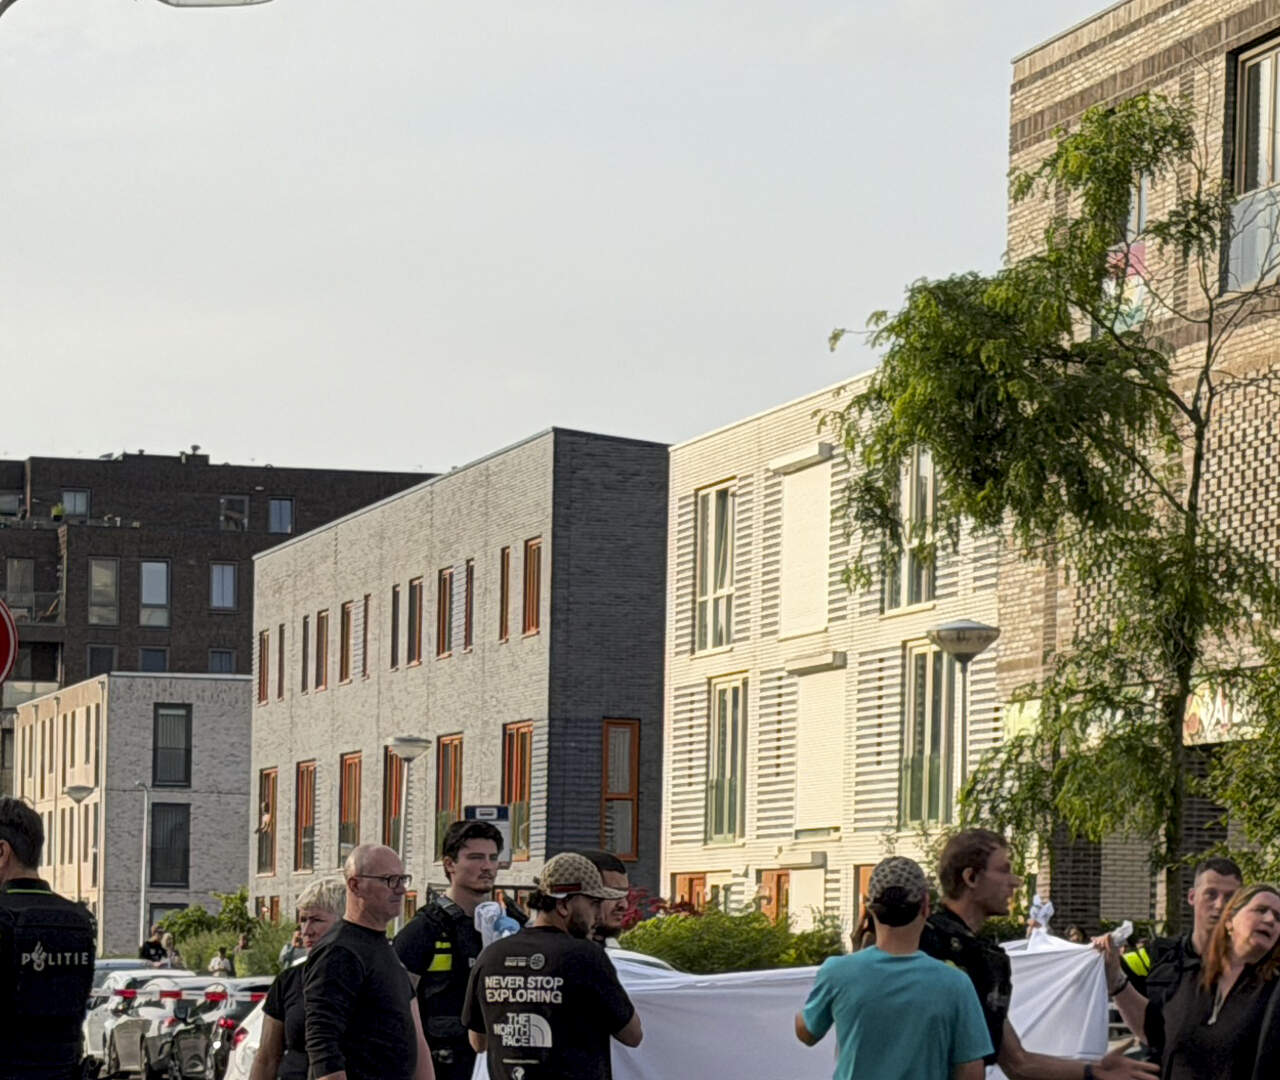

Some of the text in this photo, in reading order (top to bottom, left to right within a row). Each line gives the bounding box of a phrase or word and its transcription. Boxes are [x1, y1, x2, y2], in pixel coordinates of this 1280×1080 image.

[21, 946, 89, 971] POLITIE
[485, 976, 564, 990] NEVER STOP
[486, 989, 563, 1004] EXPLORING
[506, 1012, 530, 1025] THE
[493, 1023, 530, 1036] NORTH
[502, 1034, 530, 1047] FACE
